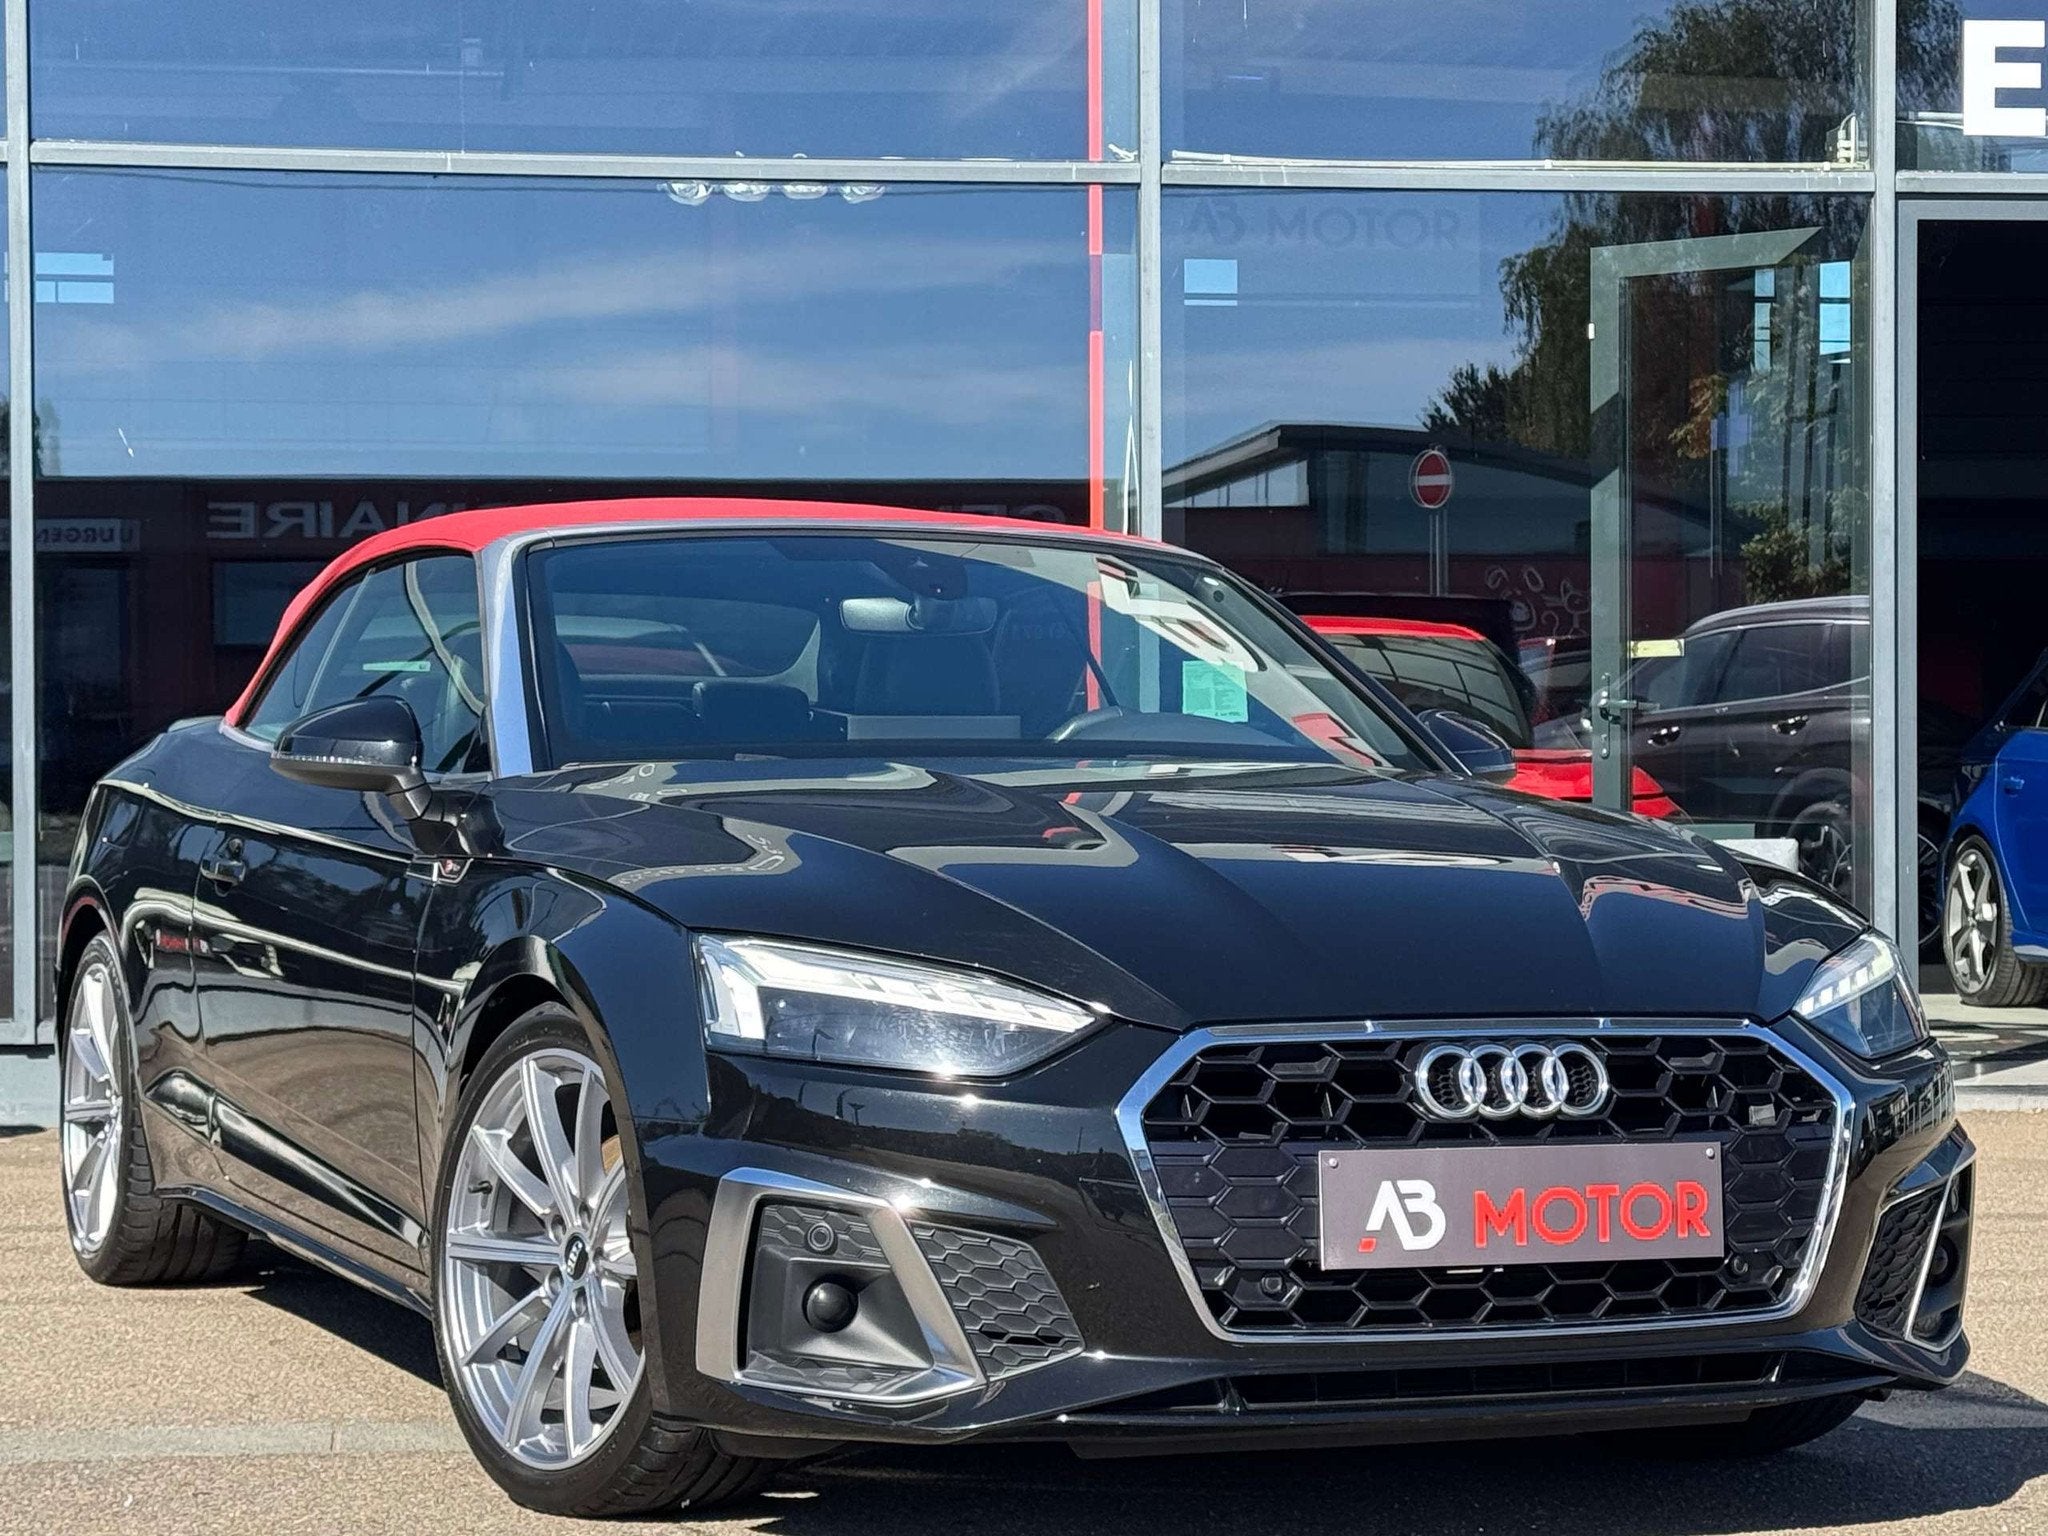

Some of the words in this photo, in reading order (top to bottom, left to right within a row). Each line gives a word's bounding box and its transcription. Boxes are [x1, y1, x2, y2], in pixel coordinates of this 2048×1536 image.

[1963, 20, 2047, 136] E
[1187, 201, 1246, 244] AB
[1268, 206, 1461, 249] MOTOR
[1358, 1180, 1446, 1251] AB
[1474, 1181, 1711, 1248] MOTOR
